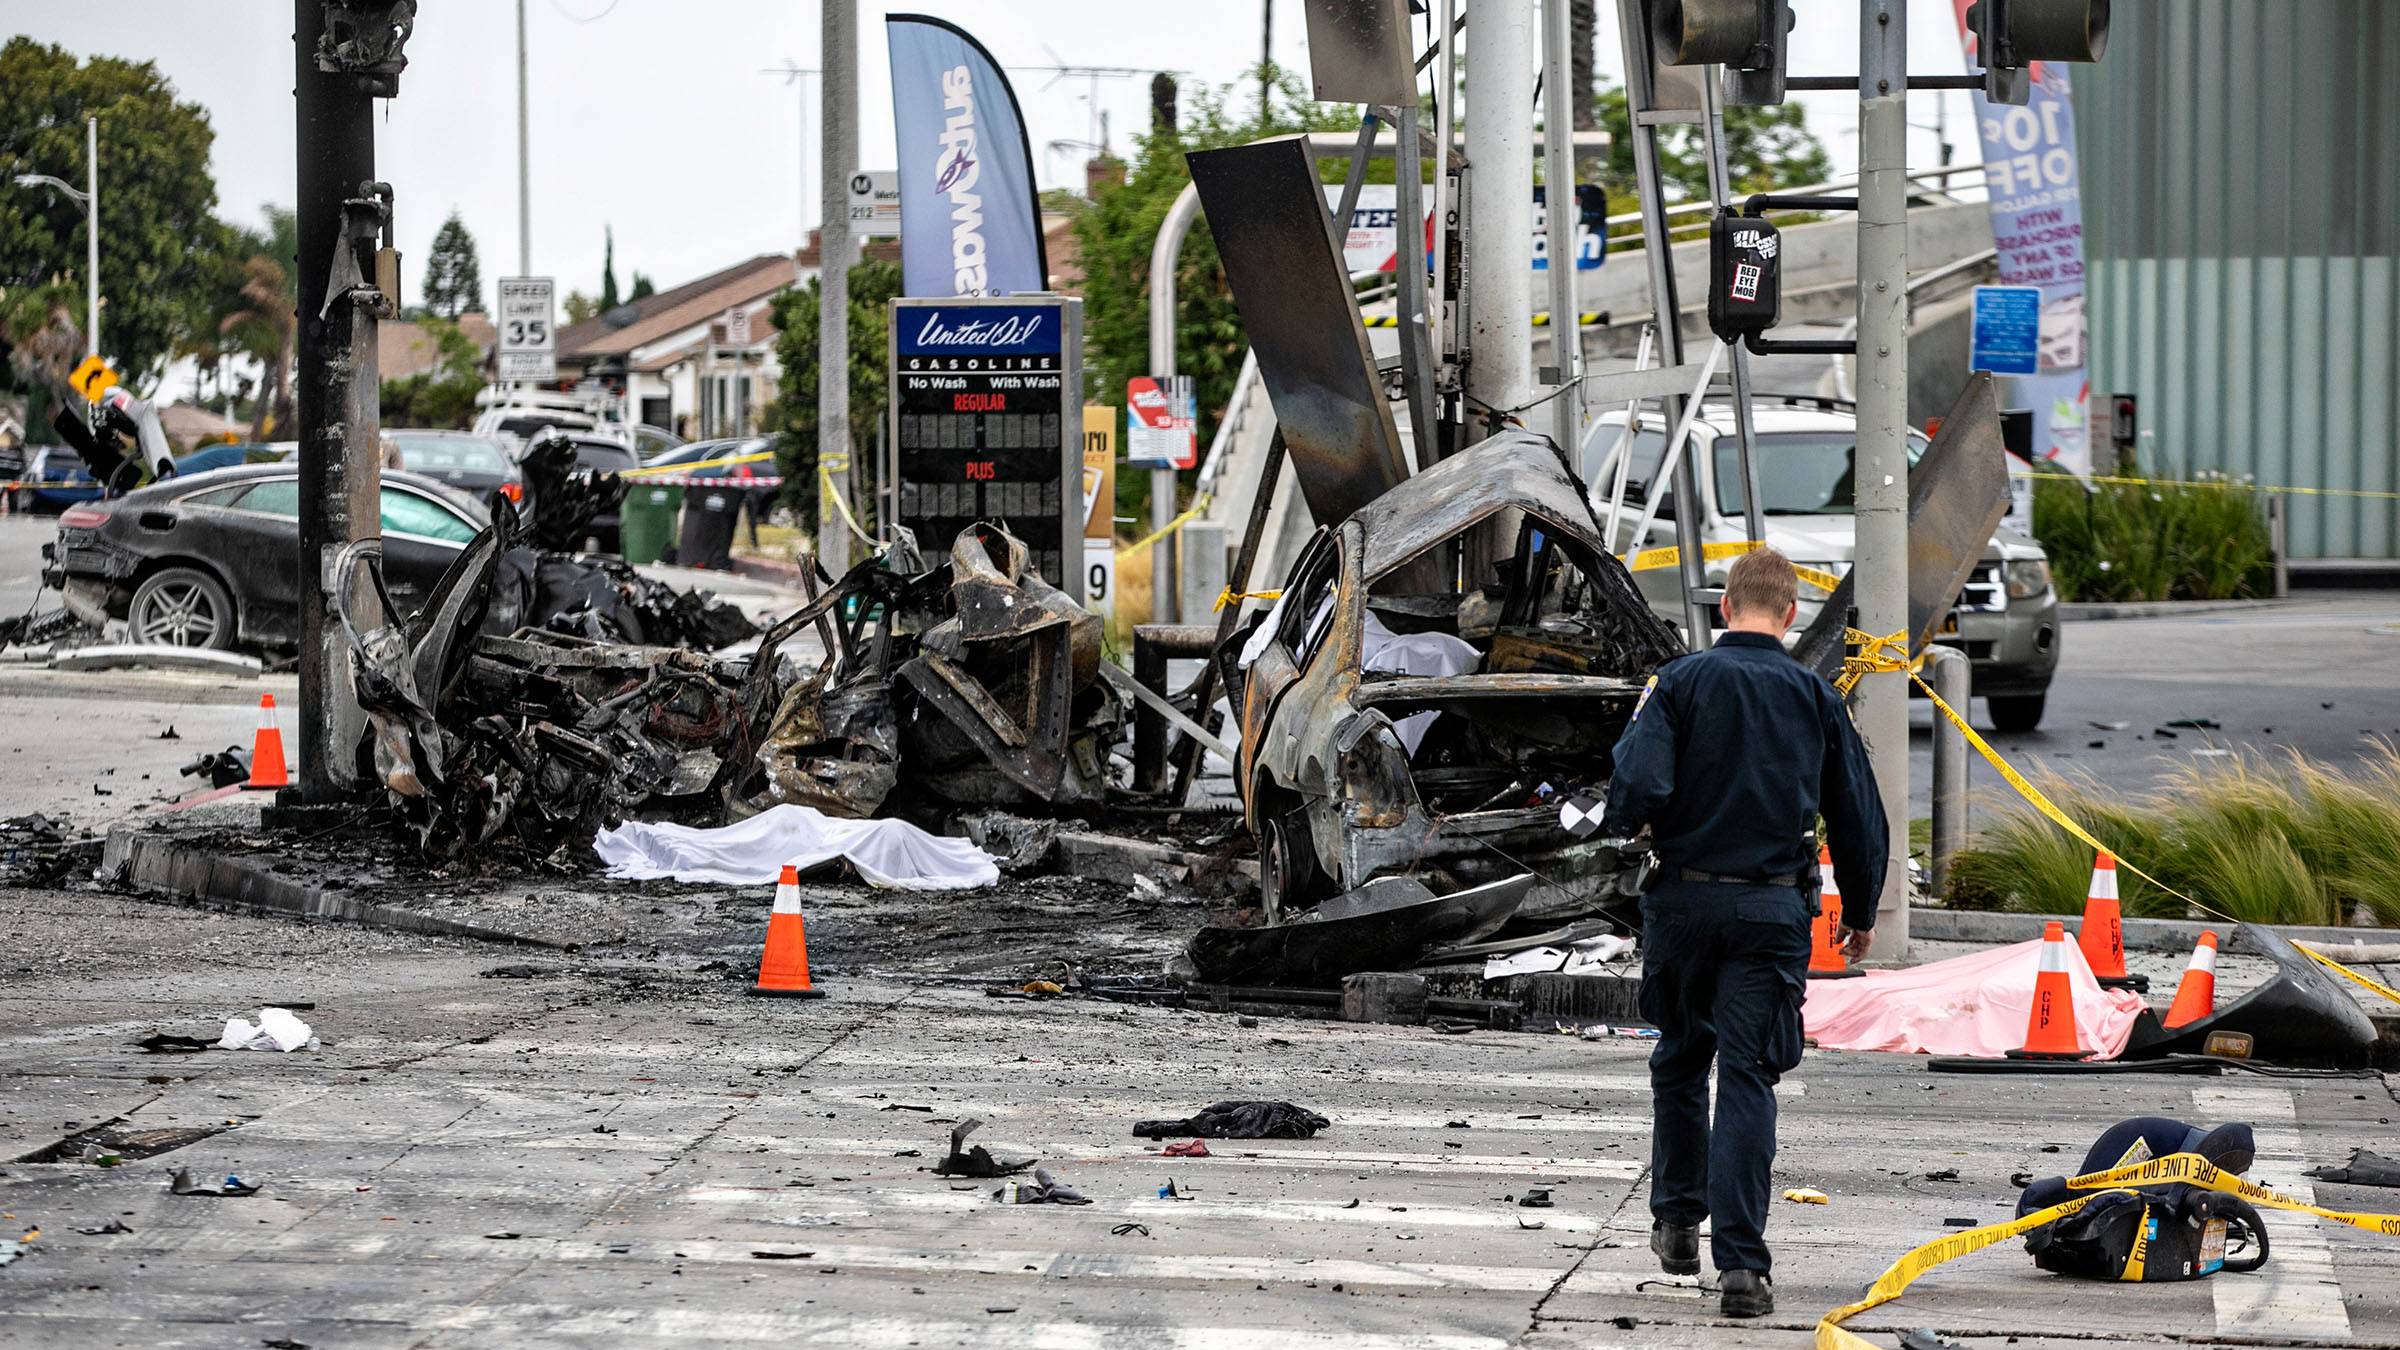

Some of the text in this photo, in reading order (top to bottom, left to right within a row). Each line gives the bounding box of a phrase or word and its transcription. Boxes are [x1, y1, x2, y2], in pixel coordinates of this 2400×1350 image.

[851, 206, 873, 218] 212
[1739, 276, 1755, 287] EYE
[1740, 266, 1757, 278] RED
[503, 284, 550, 298] SPEED
[1734, 286, 1754, 298] MOB
[506, 303, 545, 315] LIMIT
[507, 320, 547, 346] 35
[917, 312, 1042, 347] United Oil
[909, 358, 1050, 370] GASOLINE
[909, 376, 1060, 389] No Wash With Wash
[954, 392, 1006, 412] REGULAR
[966, 461, 995, 480] PLUS
[1089, 564, 1107, 601] 9
[2040, 991, 2050, 1029] CHP
[2143, 1159, 2160, 1179] DO
[2162, 1157, 2189, 1177] LINE
[2193, 1161, 2218, 1184] FIRE
